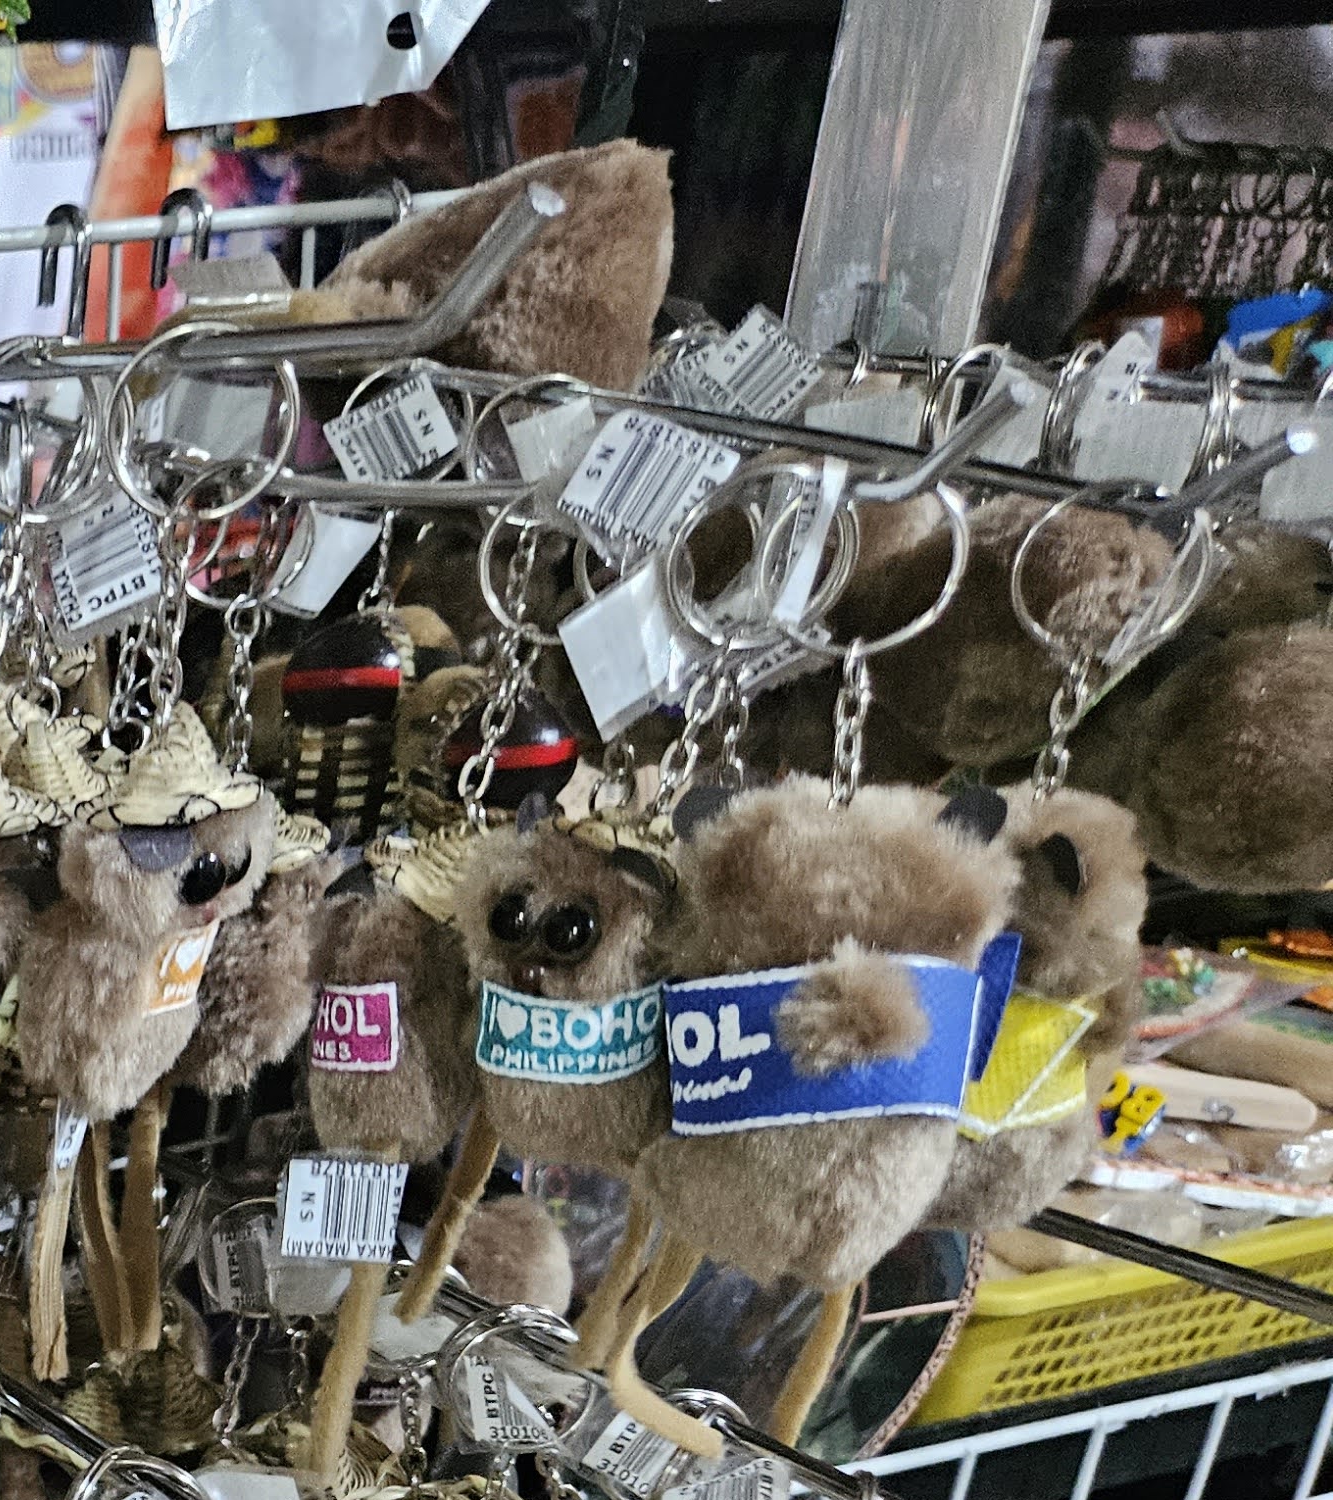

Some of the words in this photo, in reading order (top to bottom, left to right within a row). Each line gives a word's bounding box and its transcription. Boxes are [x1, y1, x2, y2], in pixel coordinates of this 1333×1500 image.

[87, 574, 147, 616] BTPC
[299, 1210, 315, 1224] S
[286, 1238, 352, 1258] (MADAM)
[481, 1371, 499, 1420] BTPC
